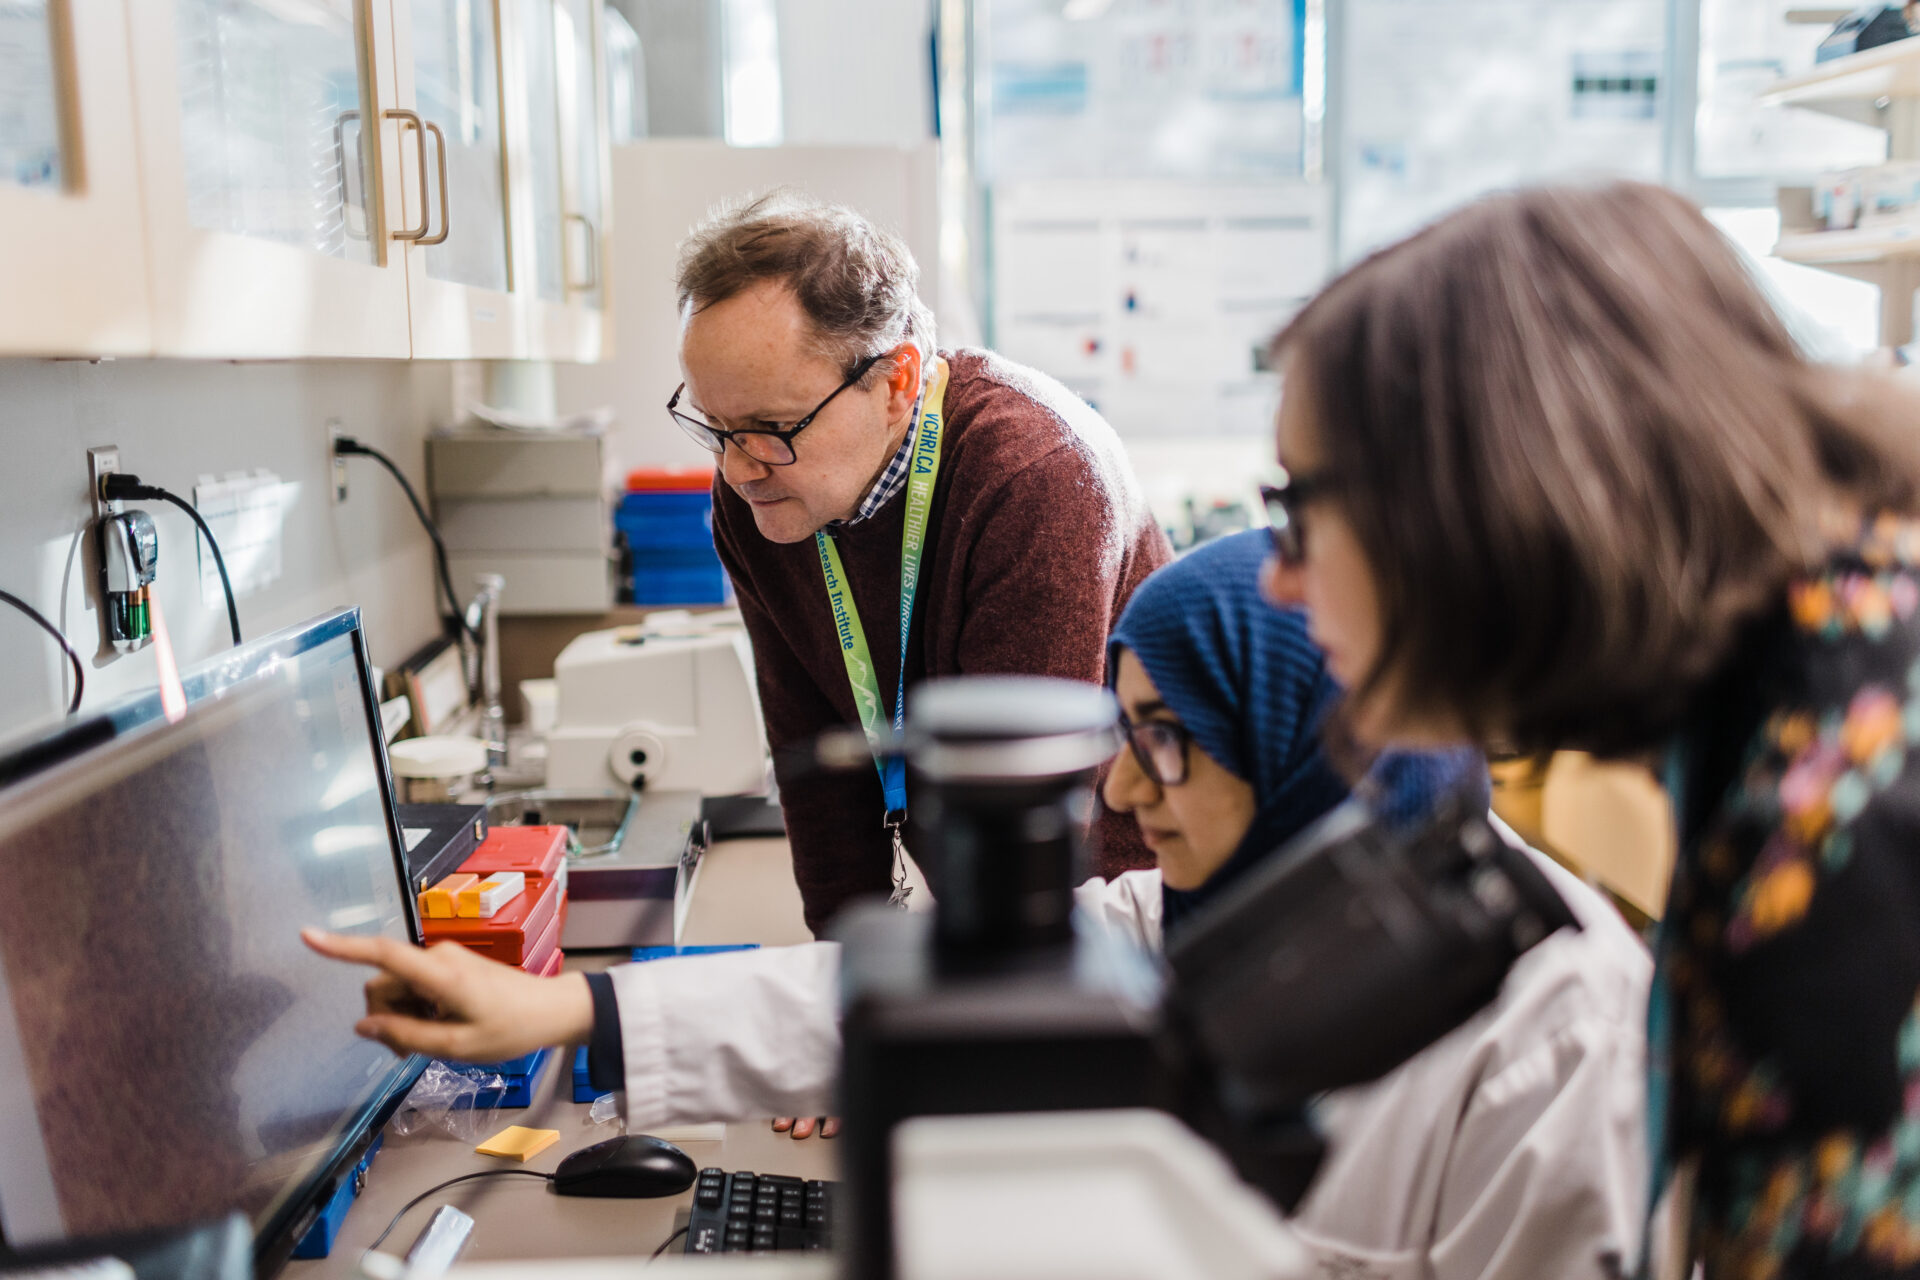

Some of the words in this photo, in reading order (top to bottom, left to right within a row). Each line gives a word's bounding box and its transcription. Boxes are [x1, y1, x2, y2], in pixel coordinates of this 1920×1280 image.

[914, 413, 939, 474] VCHRI.CA
[905, 480, 929, 551] HEALTHIER
[816, 531, 838, 589] Research
[831, 590, 854, 650] Institute
[903, 554, 917, 590] LIVES
